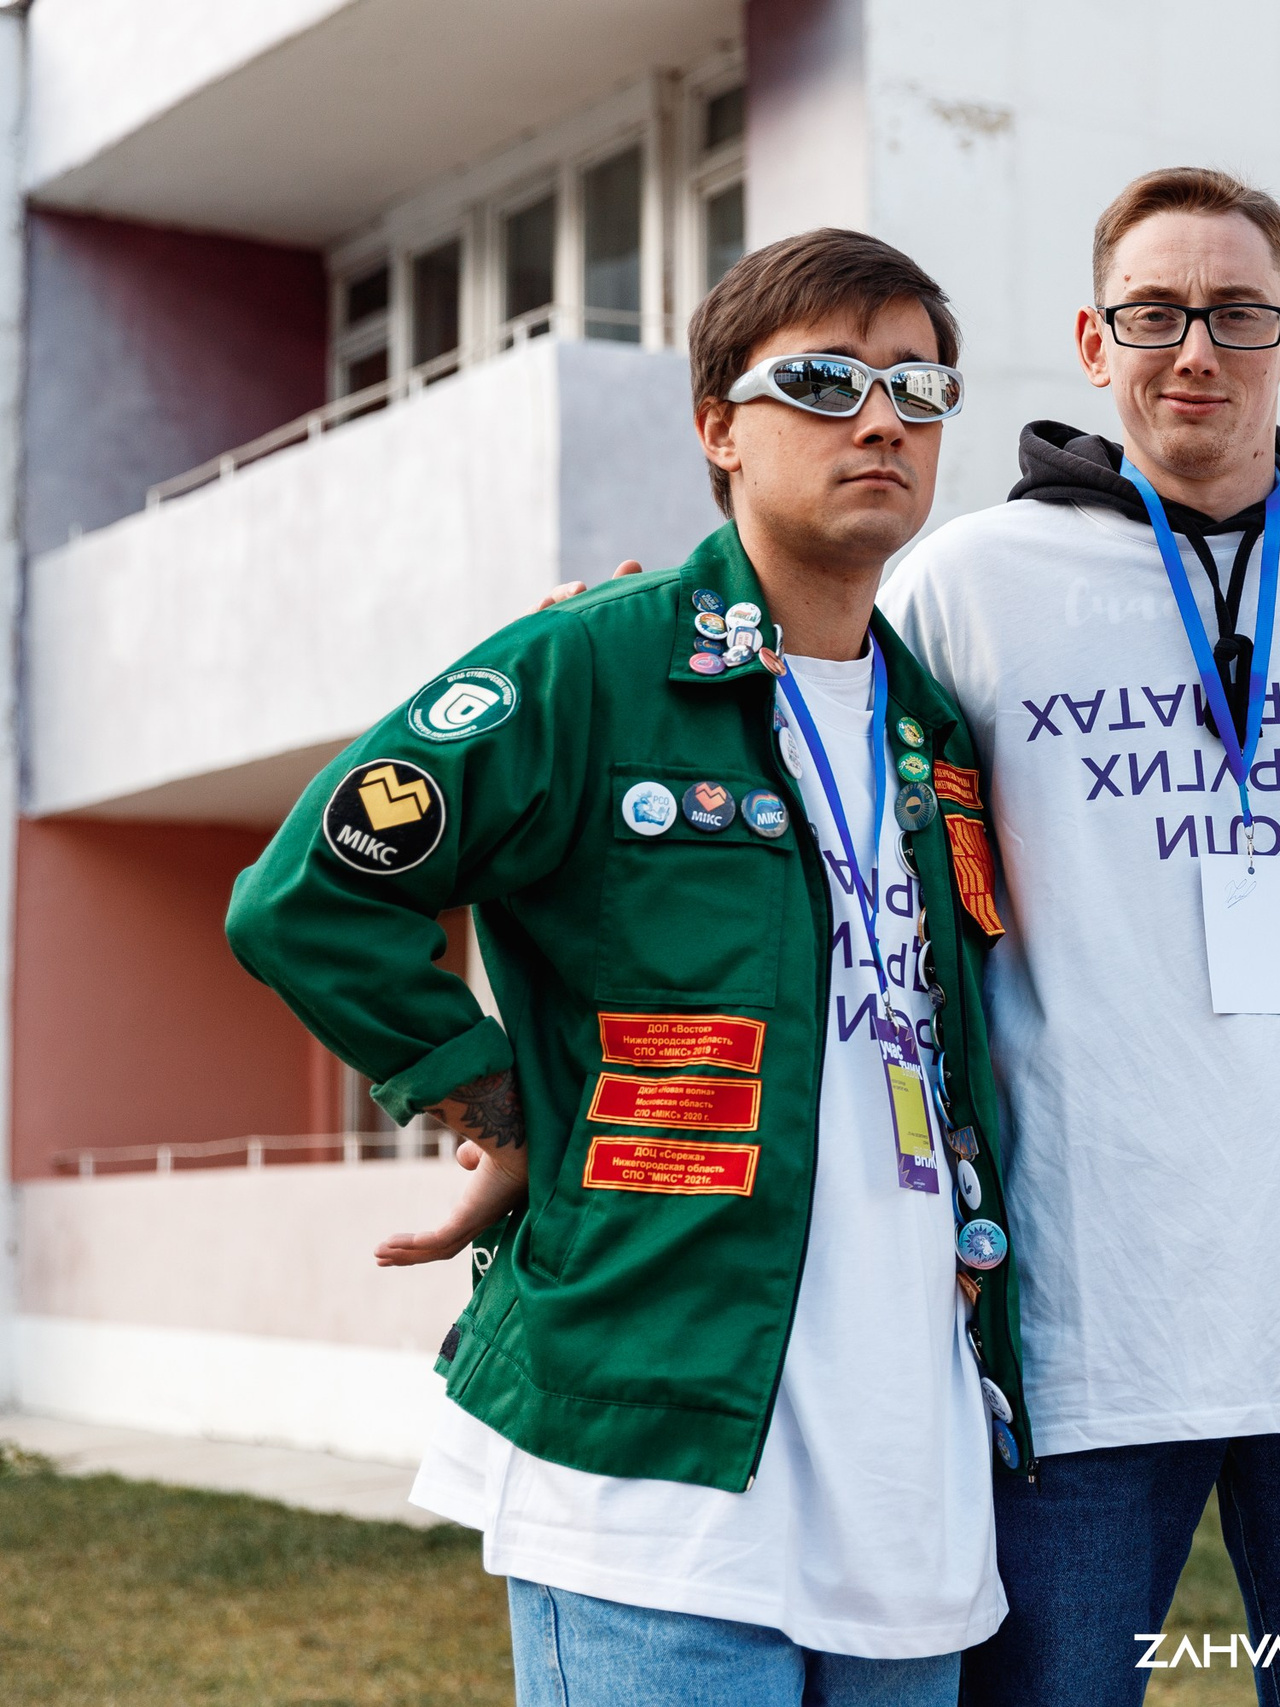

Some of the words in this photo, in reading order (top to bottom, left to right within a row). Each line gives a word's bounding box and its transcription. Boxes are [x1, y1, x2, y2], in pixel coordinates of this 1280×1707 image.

[647, 1024, 669, 1034] ДОЛ
[672, 1024, 712, 1034] «Восток»
[623, 1035, 695, 1045] Нижегородская
[697, 1035, 733, 1046] область
[634, 1047, 656, 1056] СПО
[685, 1088, 715, 1096] волна»
[635, 1098, 677, 1106] Московская
[679, 1099, 713, 1108] область
[634, 1109, 650, 1117] СПО
[683, 1112, 702, 1120] 2020
[634, 1147, 657, 1158] ДОЦ
[659, 1150, 705, 1161] «Сережа»
[612, 1157, 685, 1172] Нижегородская
[687, 1164, 725, 1173] область
[622, 1169, 644, 1180] СПО
